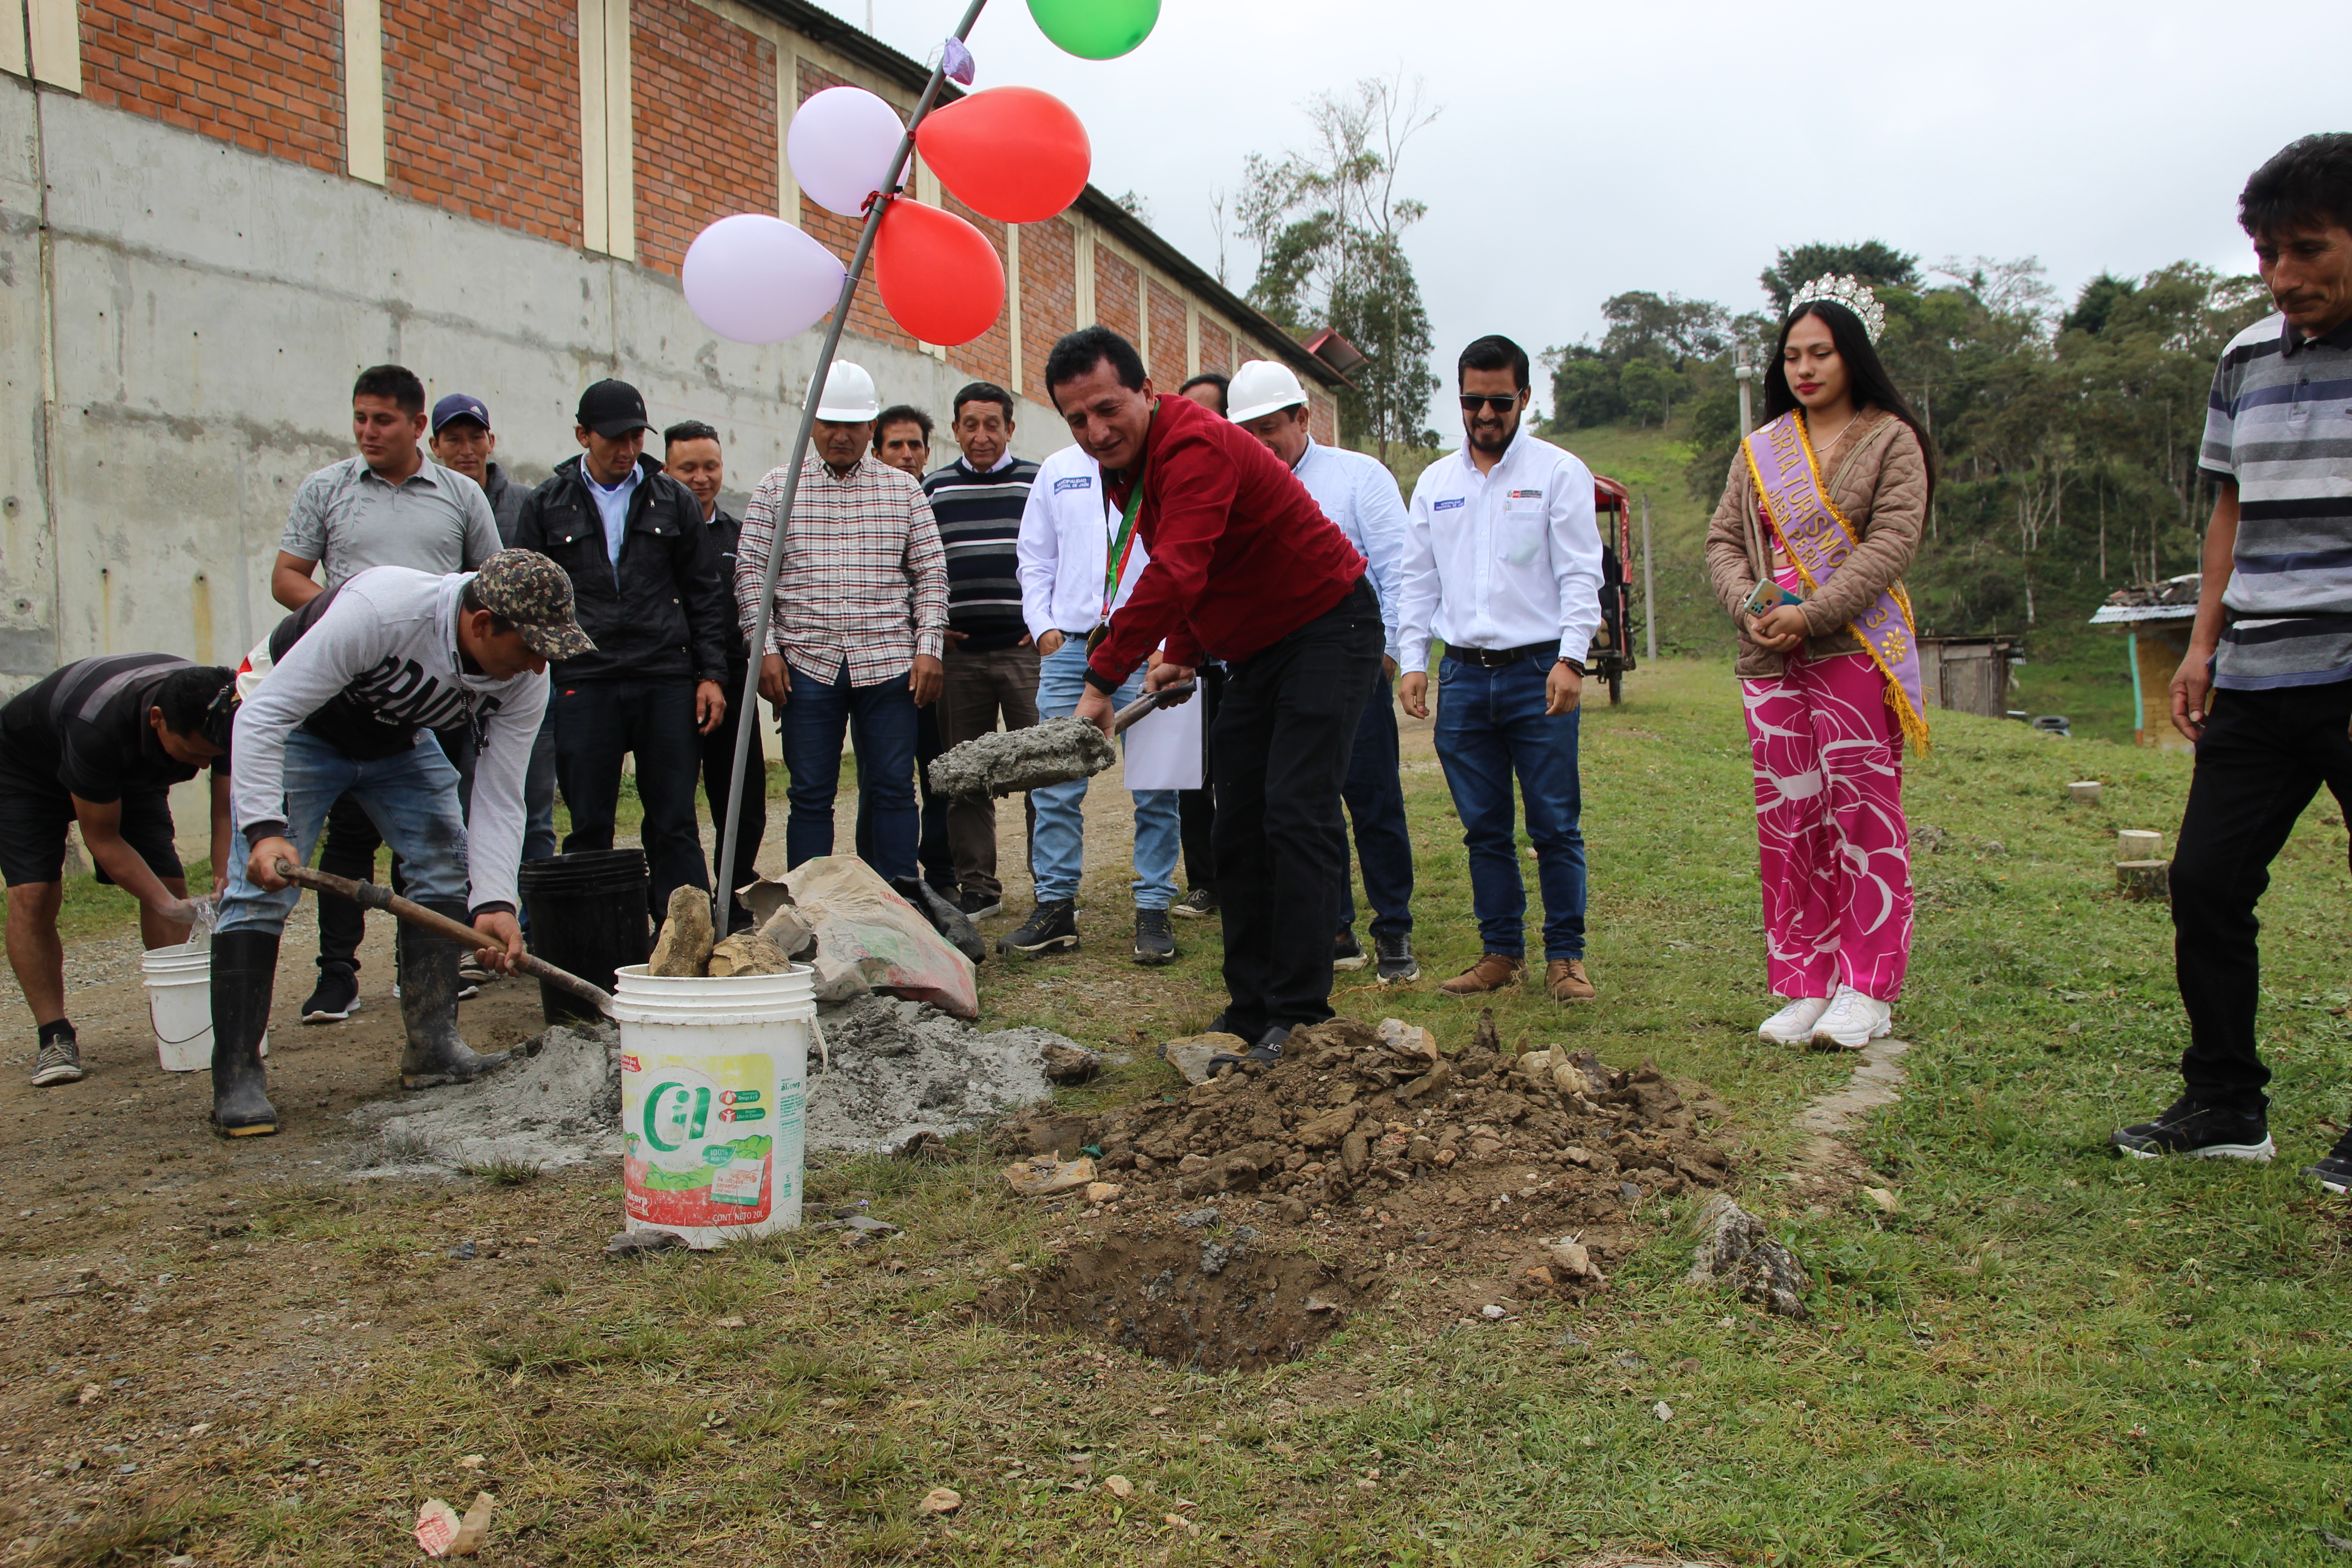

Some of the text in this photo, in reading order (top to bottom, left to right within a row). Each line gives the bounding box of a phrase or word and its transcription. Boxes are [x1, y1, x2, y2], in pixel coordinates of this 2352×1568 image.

[1770, 488, 1823, 571] JAEN PERU
[1784, 470, 1851, 568] TURISMO
[786, 1174, 790, 1182] 5
[712, 1213, 733, 1222] CONT.
[735, 1211, 752, 1220] NETO
